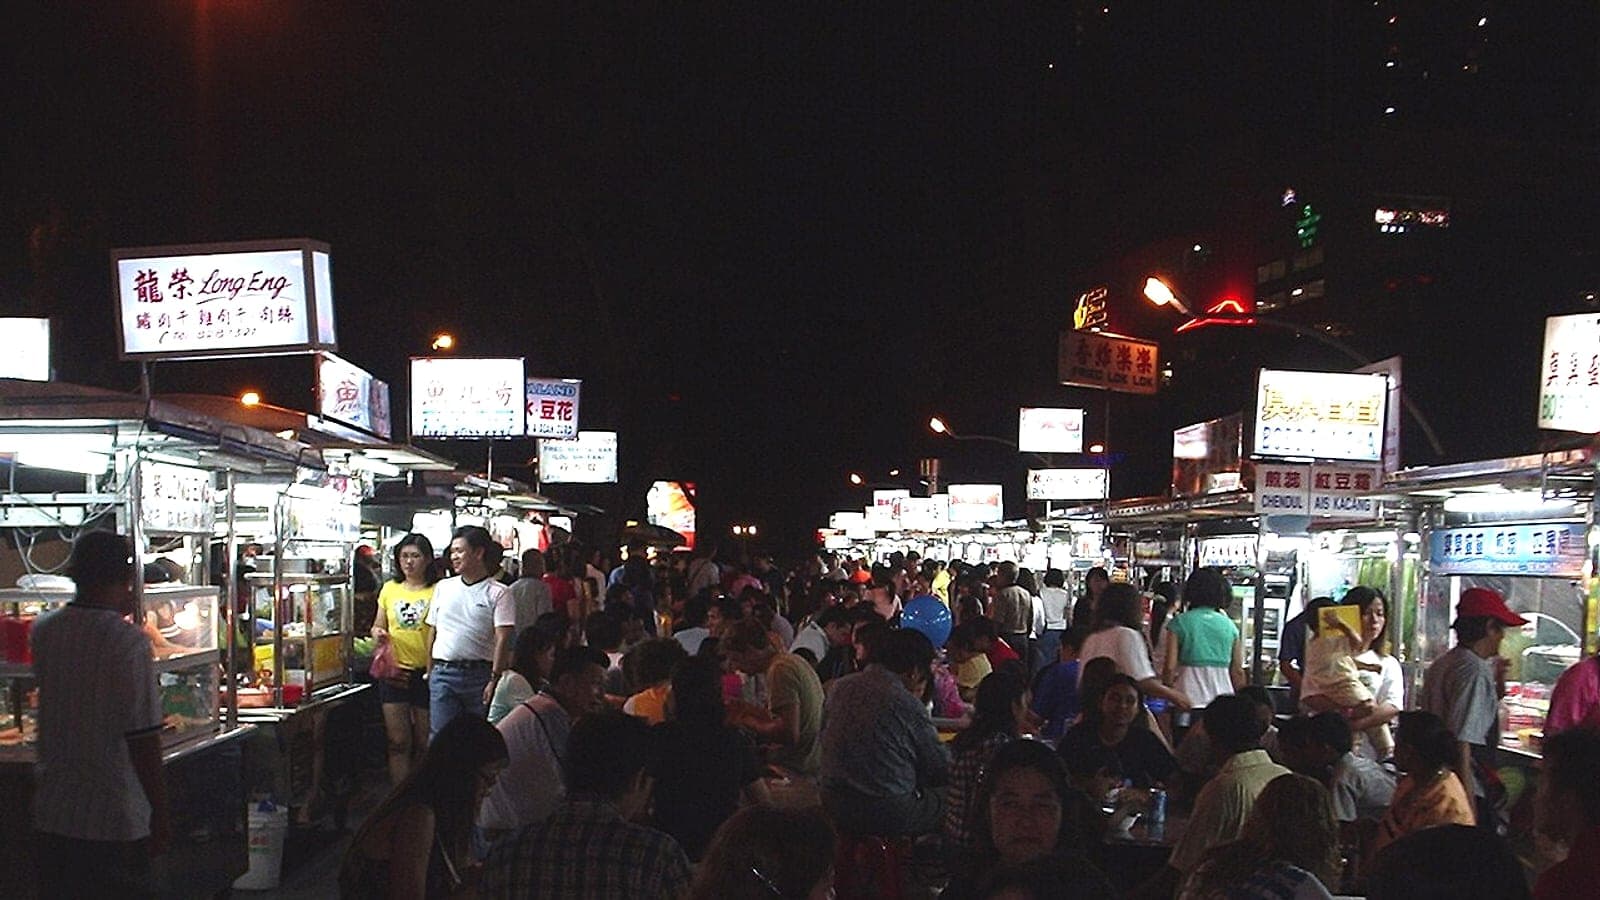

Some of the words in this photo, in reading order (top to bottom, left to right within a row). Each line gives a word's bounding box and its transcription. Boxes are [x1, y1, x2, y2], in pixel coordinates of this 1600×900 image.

[133, 268, 195, 303] 龍榮
[198, 269, 245, 300] Long
[247, 271, 292, 299] Eng
[1314, 496, 1330, 510] AIS
[1333, 497, 1371, 512] KACANG
